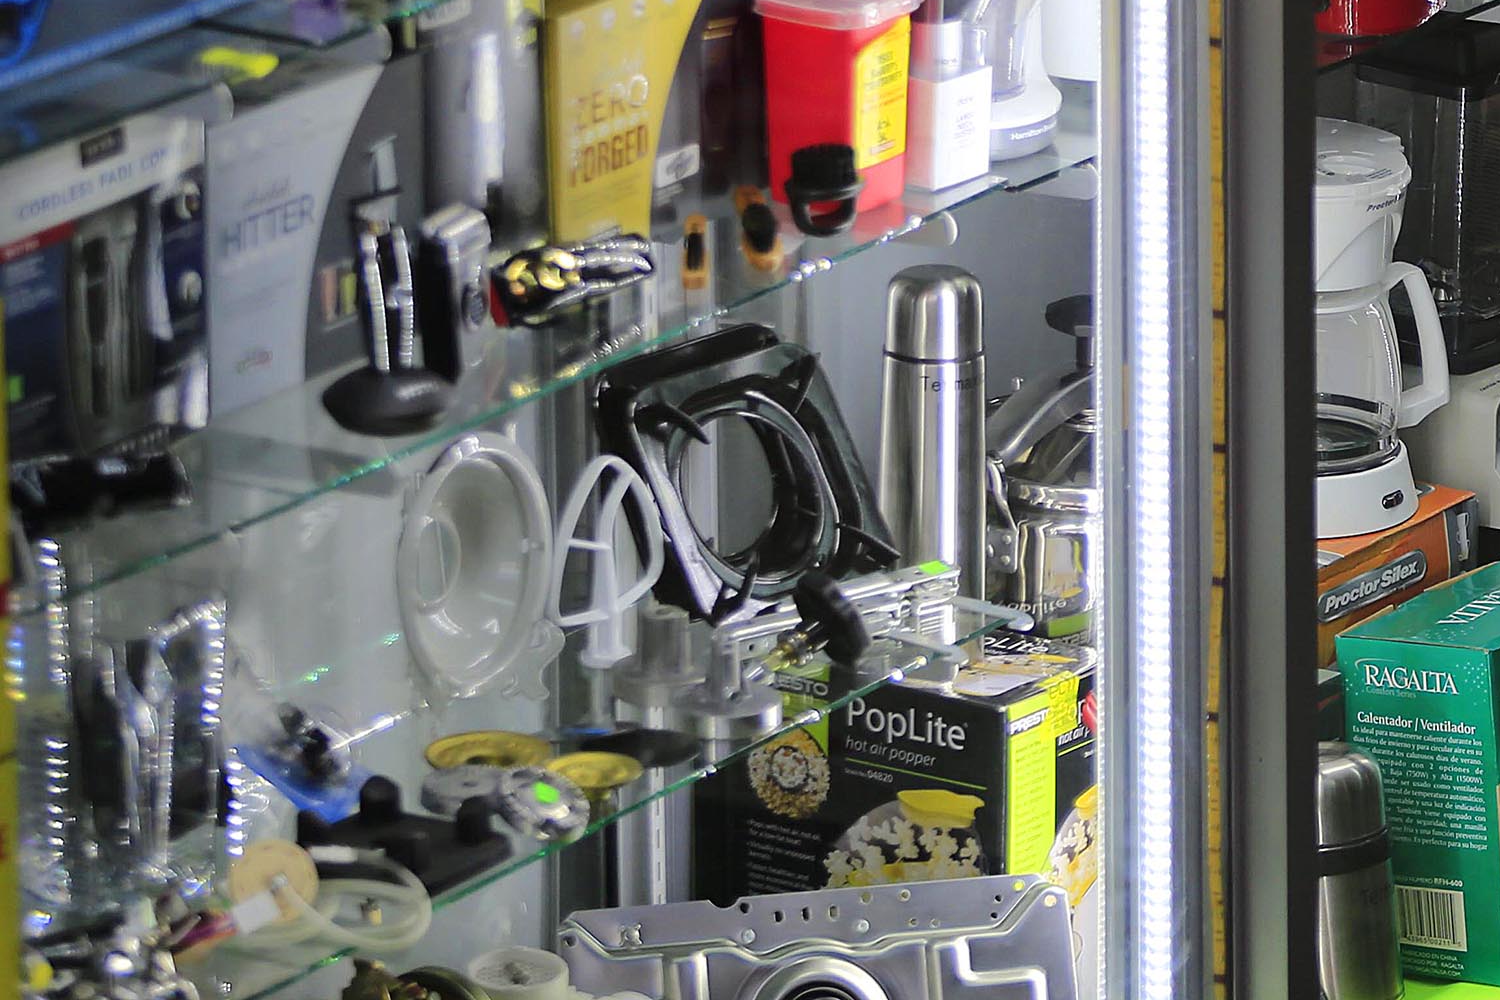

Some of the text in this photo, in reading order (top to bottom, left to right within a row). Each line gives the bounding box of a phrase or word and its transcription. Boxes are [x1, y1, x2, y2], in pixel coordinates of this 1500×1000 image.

[1363, 664, 1460, 696] RAGALTA
[847, 696, 966, 751] PopLite
[1010, 707, 1049, 735] PREST
[1357, 711, 1413, 729] Calentador
[1420, 718, 1477, 736] Ventilador
[1360, 725, 1375, 735] ideal
[1375, 730, 1389, 738] para
[1389, 731, 1422, 741] mantenerse
[1423, 735, 1447, 744] caliente
[1448, 737, 1472, 747] durante
[1473, 739, 1482, 747] los
[846, 735, 937, 768] hot air popper
[1379, 738, 1387, 746] de
[1417, 743, 1430, 753] para
[1431, 744, 1453, 755] circular
[1453, 748, 1466, 756] aire
[1372, 746, 1395, 756] durante
[1395, 749, 1405, 758] los
[1450, 756, 1459, 764] de
[1411, 762, 1425, 770] con
[1429, 762, 1434, 770] 2
[1438, 764, 1470, 775] opciones
[1474, 767, 1484, 775] de
[1412, 780, 1431, 789] usado
[1440, 772, 1453, 782] Alta
[1403, 789, 1412, 797] de
[1412, 790, 1449, 801] temperatura
[1444, 803, 1454, 811] de
[1443, 812, 1472, 822] equipado
[1474, 815, 1486, 823] con
[1455, 831, 1488, 842] preventiva
[1447, 840, 1461, 850] para
[1469, 841, 1488, 851] hogar
